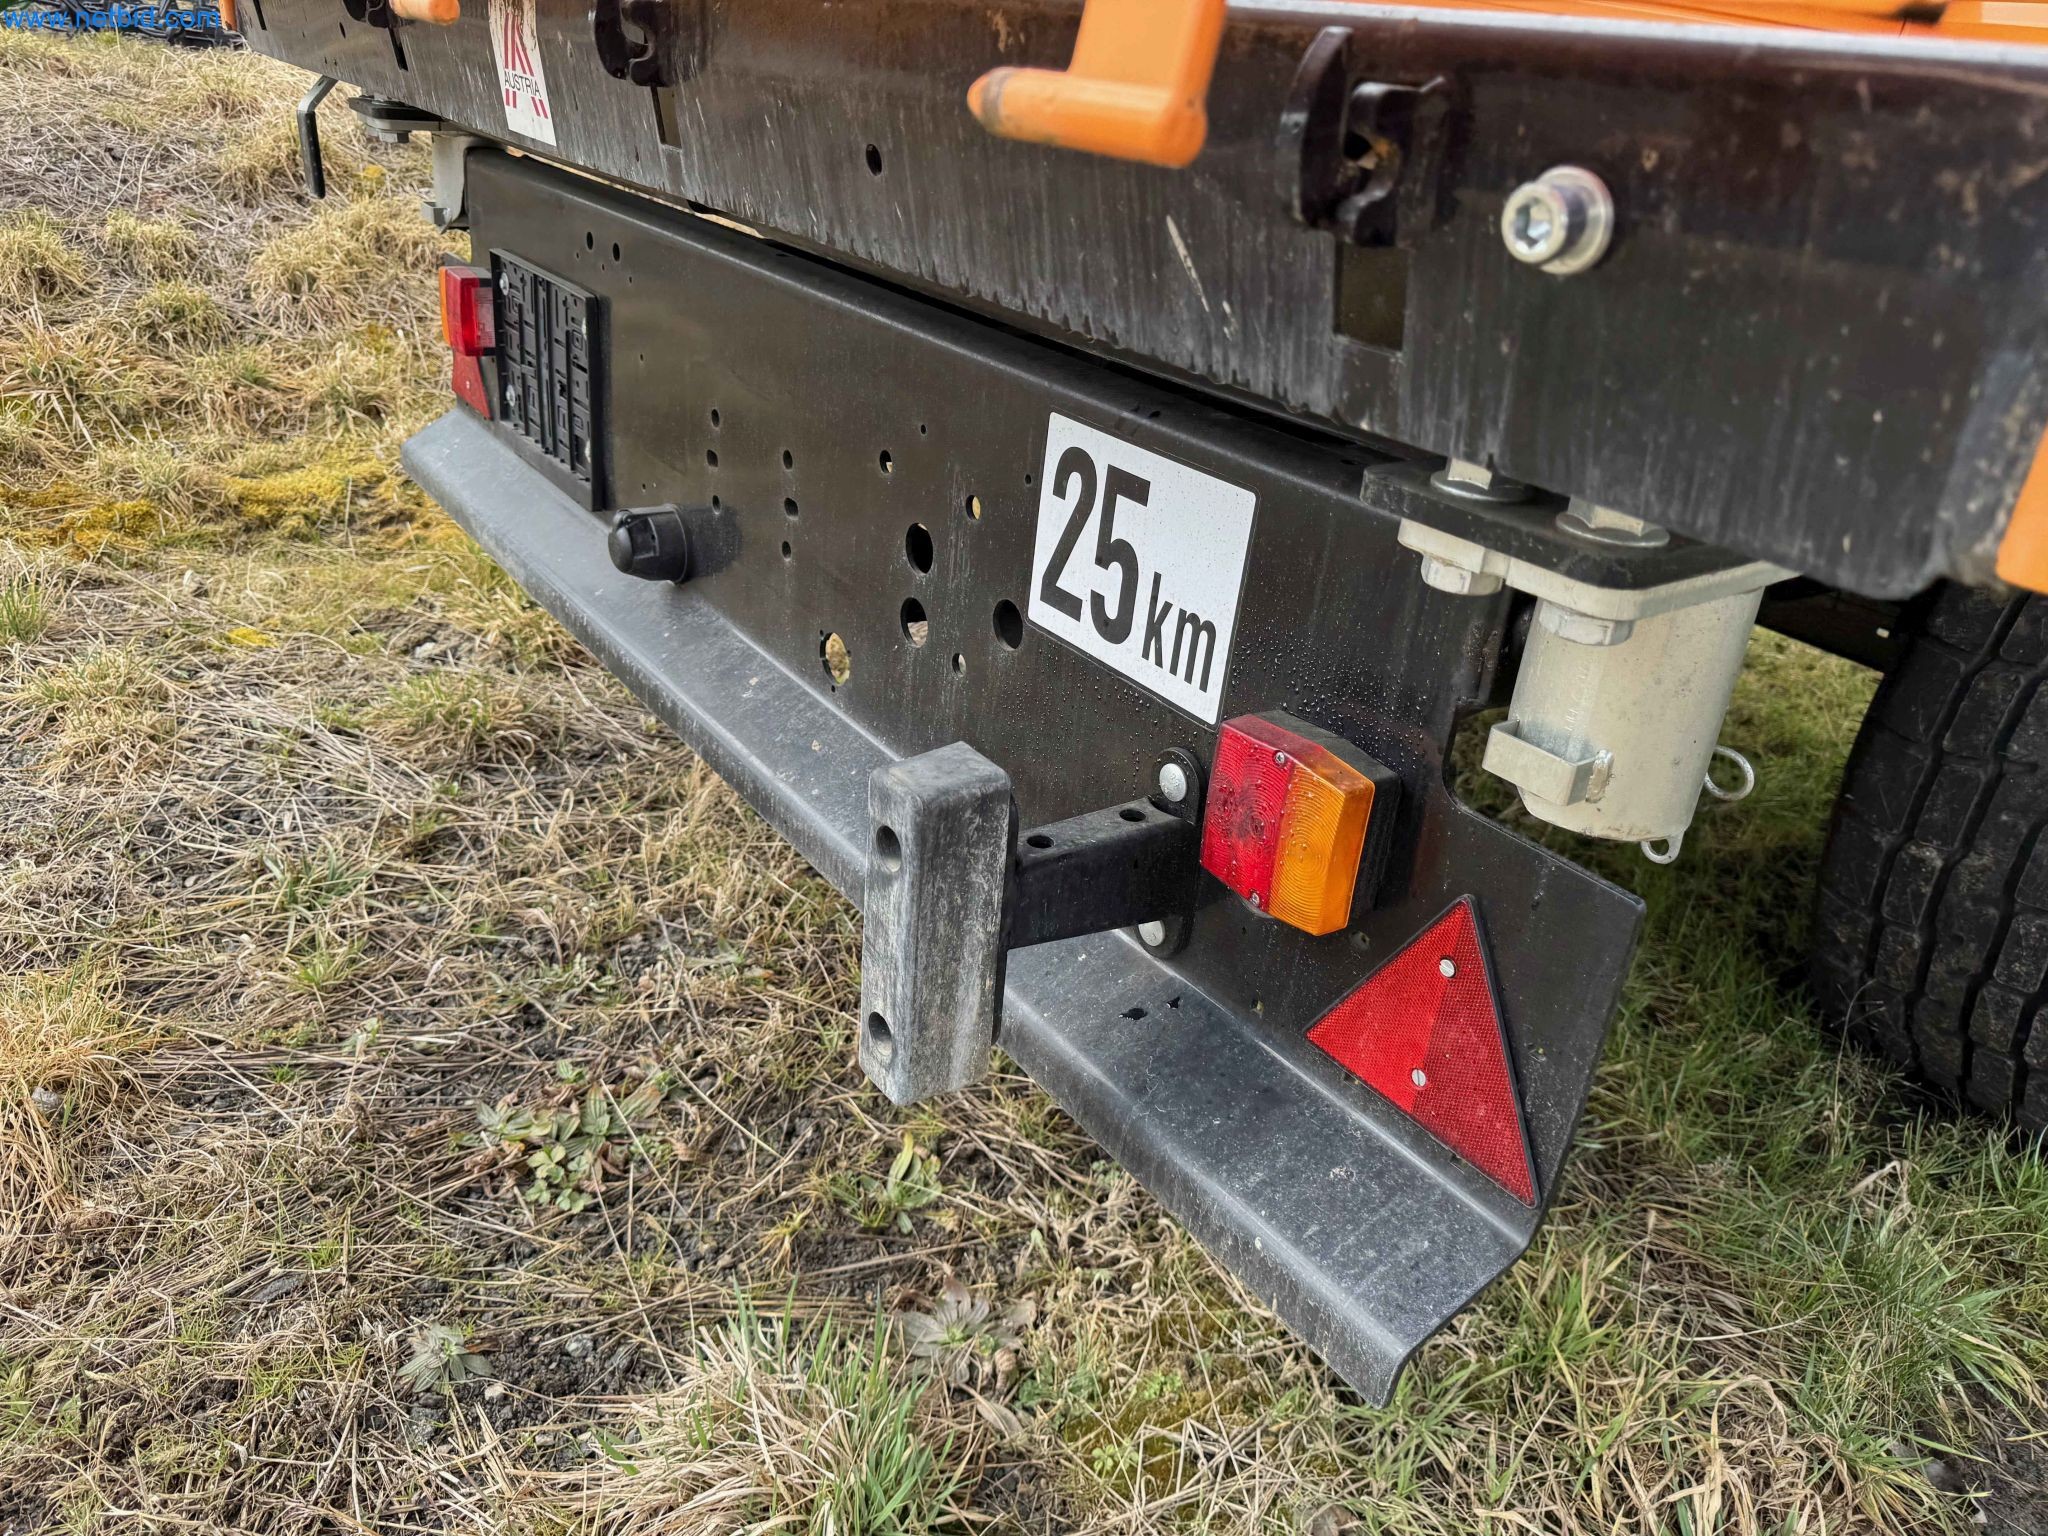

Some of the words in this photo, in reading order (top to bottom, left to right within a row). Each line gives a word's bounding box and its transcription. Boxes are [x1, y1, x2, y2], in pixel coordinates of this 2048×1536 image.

[504, 71, 542, 97] AUSTRIA
[1039, 446, 1151, 645] 25
[1141, 571, 1217, 693] km
